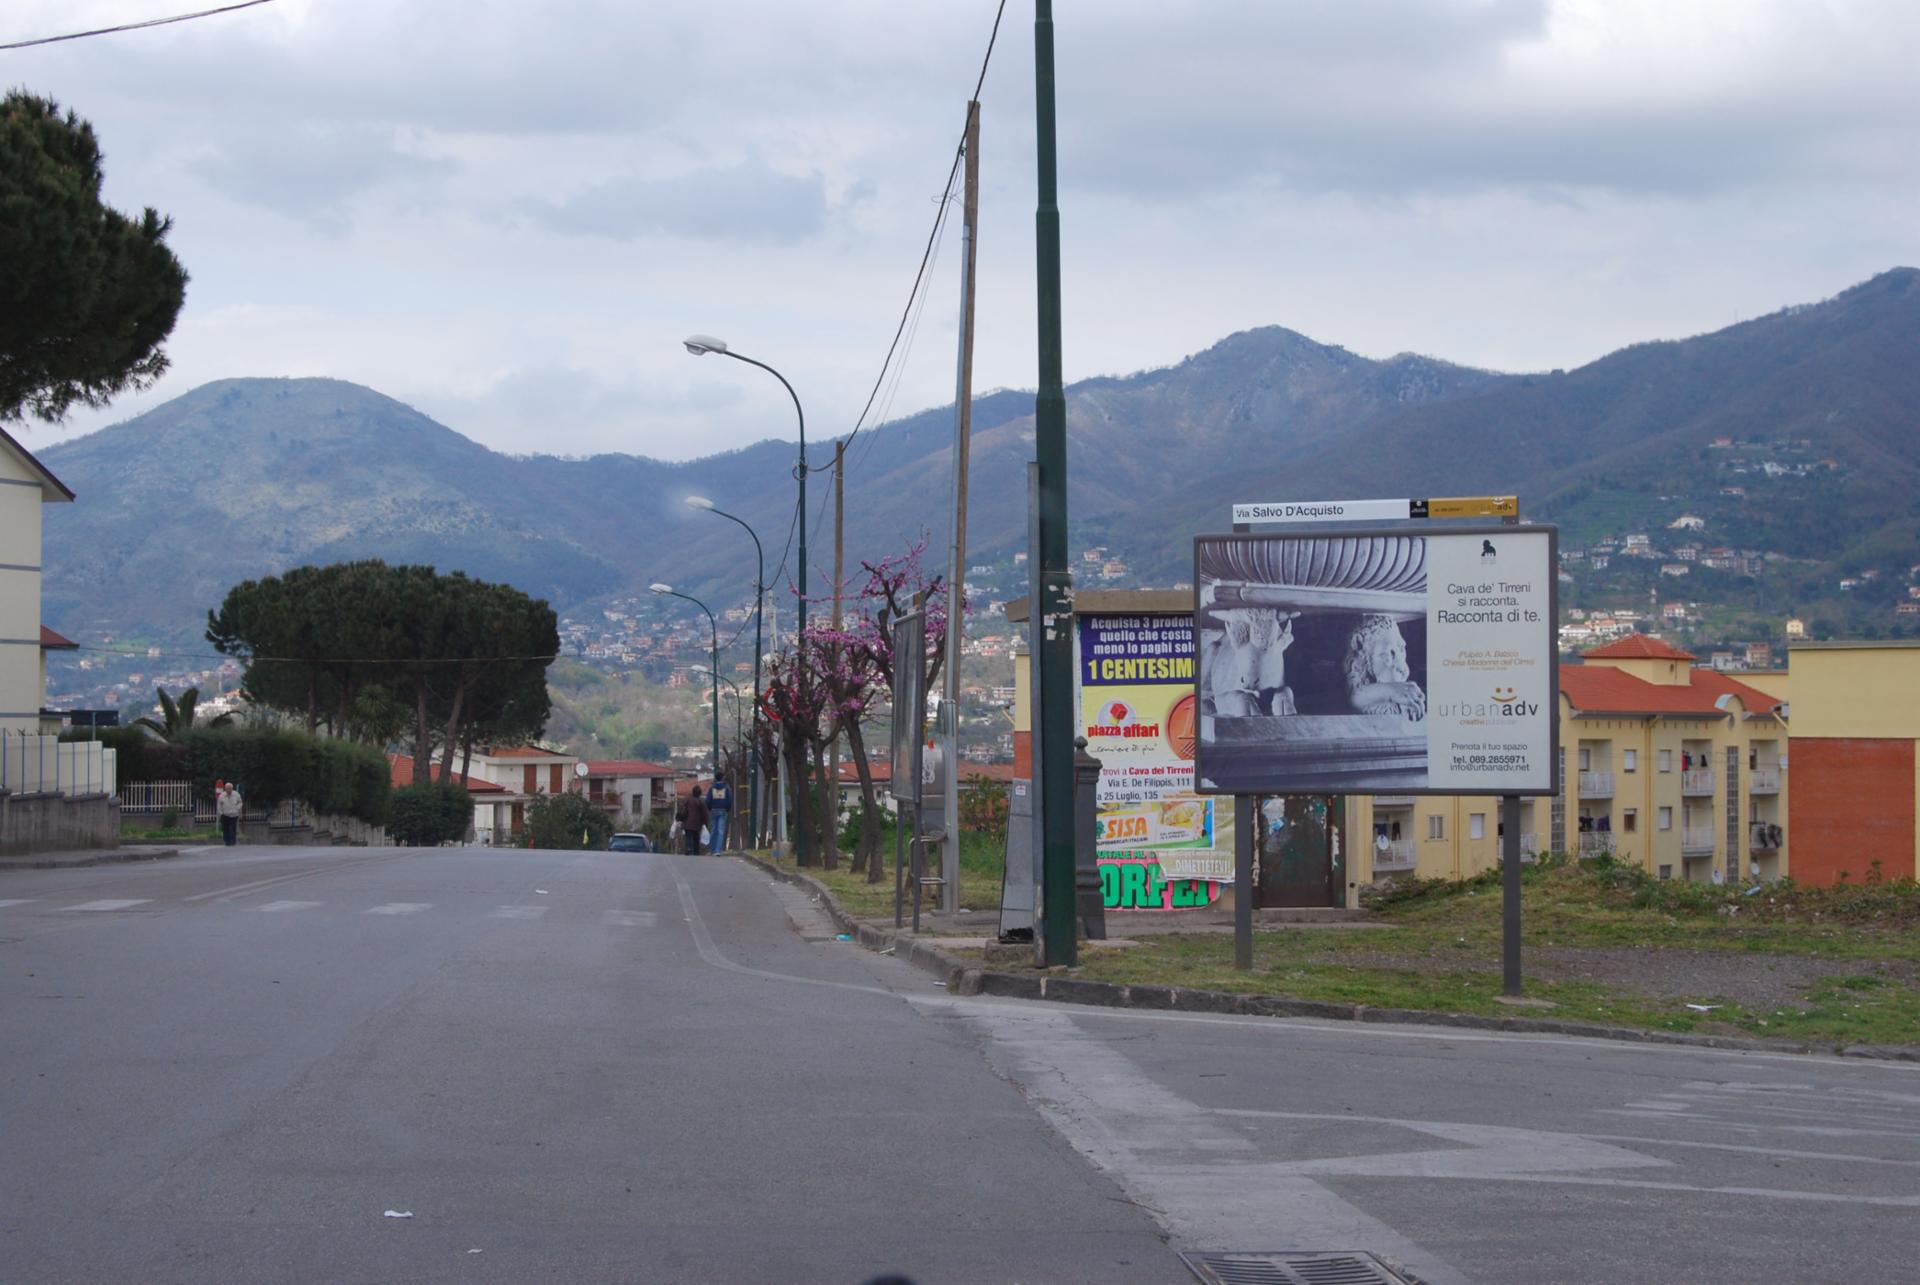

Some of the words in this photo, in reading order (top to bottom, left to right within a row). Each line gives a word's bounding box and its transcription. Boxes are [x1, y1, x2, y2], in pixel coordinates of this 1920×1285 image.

[1236, 509, 1249, 517] Via
[1253, 507, 1282, 517] Salvo
[1286, 505, 1344, 517] D'Acquisto
[1447, 583, 1475, 594] Cava
[1498, 581, 1531, 593] Tirreni
[1458, 596, 1466, 606] si
[1470, 596, 1519, 606] racconta.
[1438, 609, 1503, 623] Racconta
[1507, 608, 1520, 622] di
[1524, 608, 1541, 622] te.
[1091, 618, 1140, 630] Acquista
[1143, 617, 1150, 628] 3
[1152, 617, 1195, 629] prodott
[1100, 630, 1135, 642] quello
[1138, 630, 1158, 641] che
[1161, 630, 1192, 640] costa
[1093, 643, 1125, 655] meno
[1127, 643, 1138, 654] lo
[1140, 642, 1172, 655] paghi
[1088, 660, 1098, 680] 1
[1102, 657, 1195, 680] CENTESIM
[1088, 724, 1121, 738] piazza
[1123, 723, 1160, 738] affari
[1451, 742, 1480, 750] Prenota
[1503, 743, 1528, 752] spazio
[1453, 755, 1467, 764] tel.
[1103, 767, 1120, 776] trovi
[1128, 767, 1150, 775] Cava
[1152, 766, 1164, 775] dei
[1166, 765, 1194, 774] Tirreni
[1108, 779, 1120, 787] Via
[1132, 779, 1142, 787] De
[1177, 778, 1190, 786] 111
[1104, 792, 1114, 800] 25
[1144, 791, 1158, 800] 135
[1106, 817, 1149, 840] SISA
[1099, 863, 1210, 908] ORFEI
